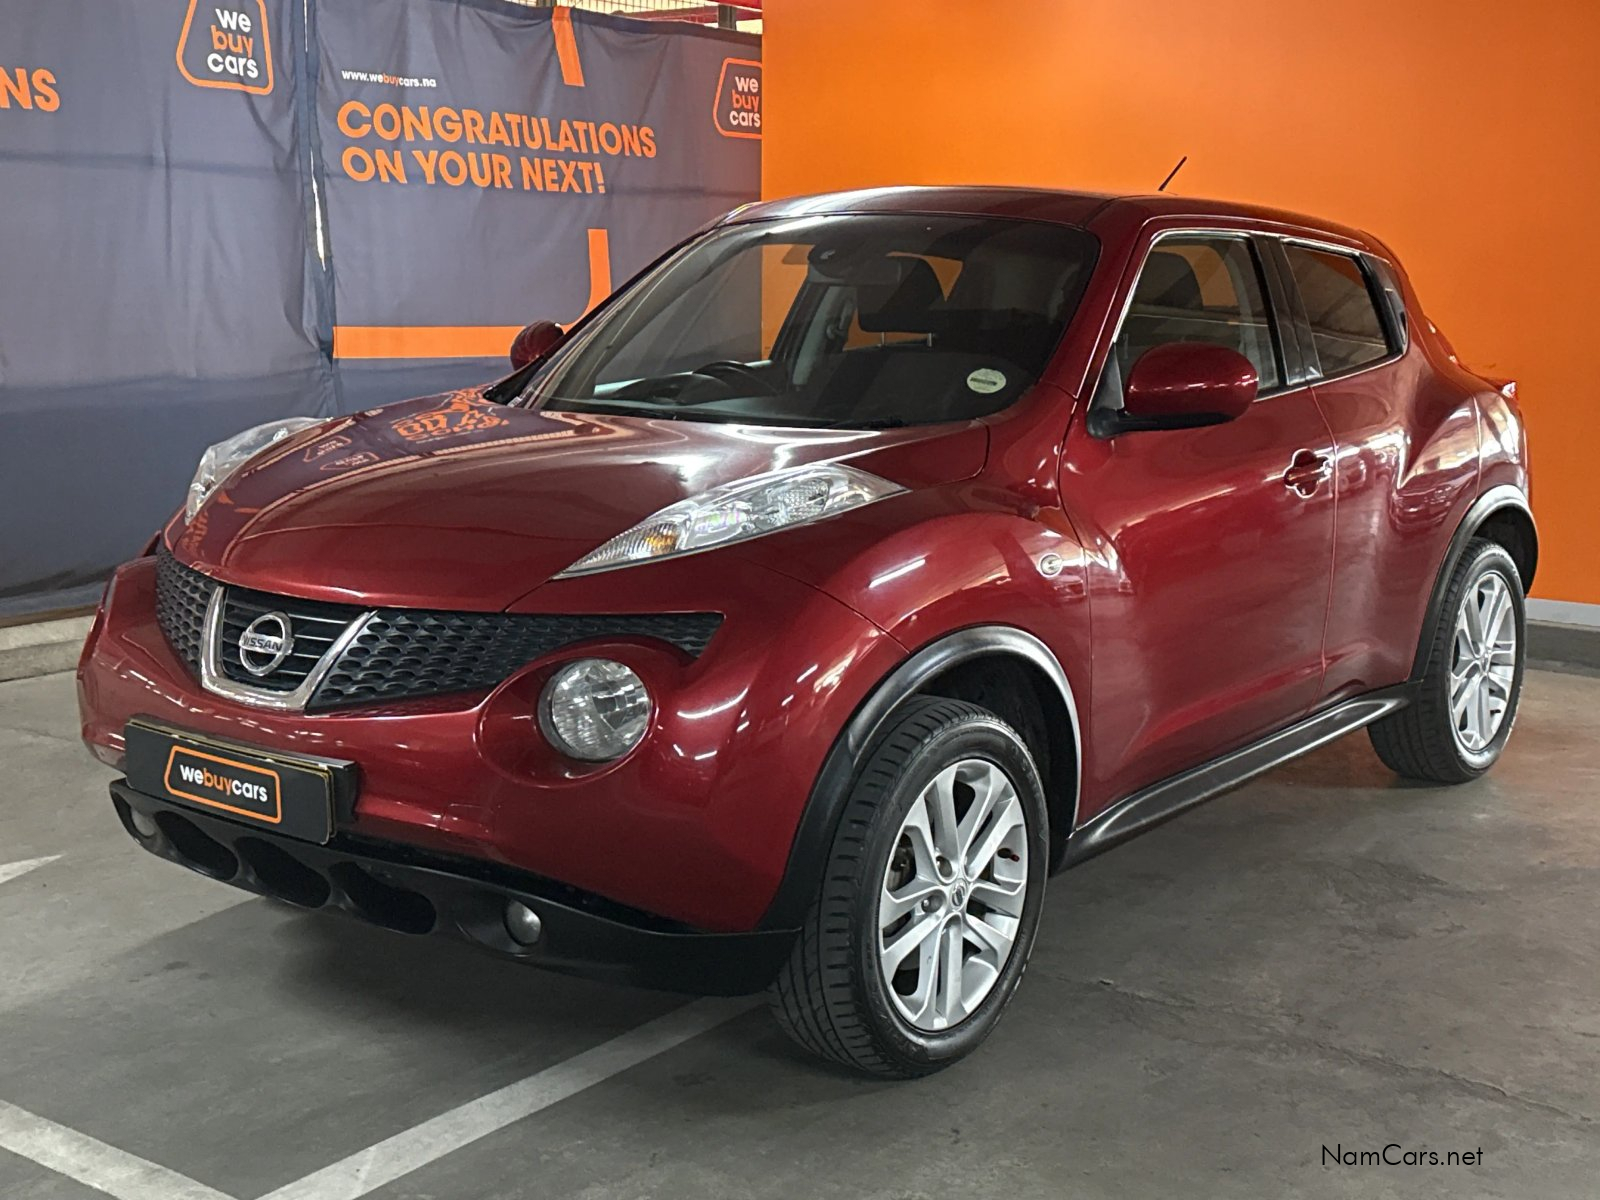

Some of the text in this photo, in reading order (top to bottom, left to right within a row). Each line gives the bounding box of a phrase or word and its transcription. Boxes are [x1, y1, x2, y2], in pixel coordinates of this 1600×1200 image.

[215, 8, 251, 32] we
[211, 25, 253, 57] buy
[207, 53, 258, 78] cars
[341, 70, 437, 88] www.webuycars.na
[734, 76, 759, 93] we
[732, 89, 760, 113] buy
[337, 100, 656, 159] CONGRATULATIONS
[729, 110, 761, 127] cars
[342, 146, 606, 195] ON YOUR NEXT!
[242, 633, 284, 652] NISSAN
[179, 763, 268, 802] webuycars
